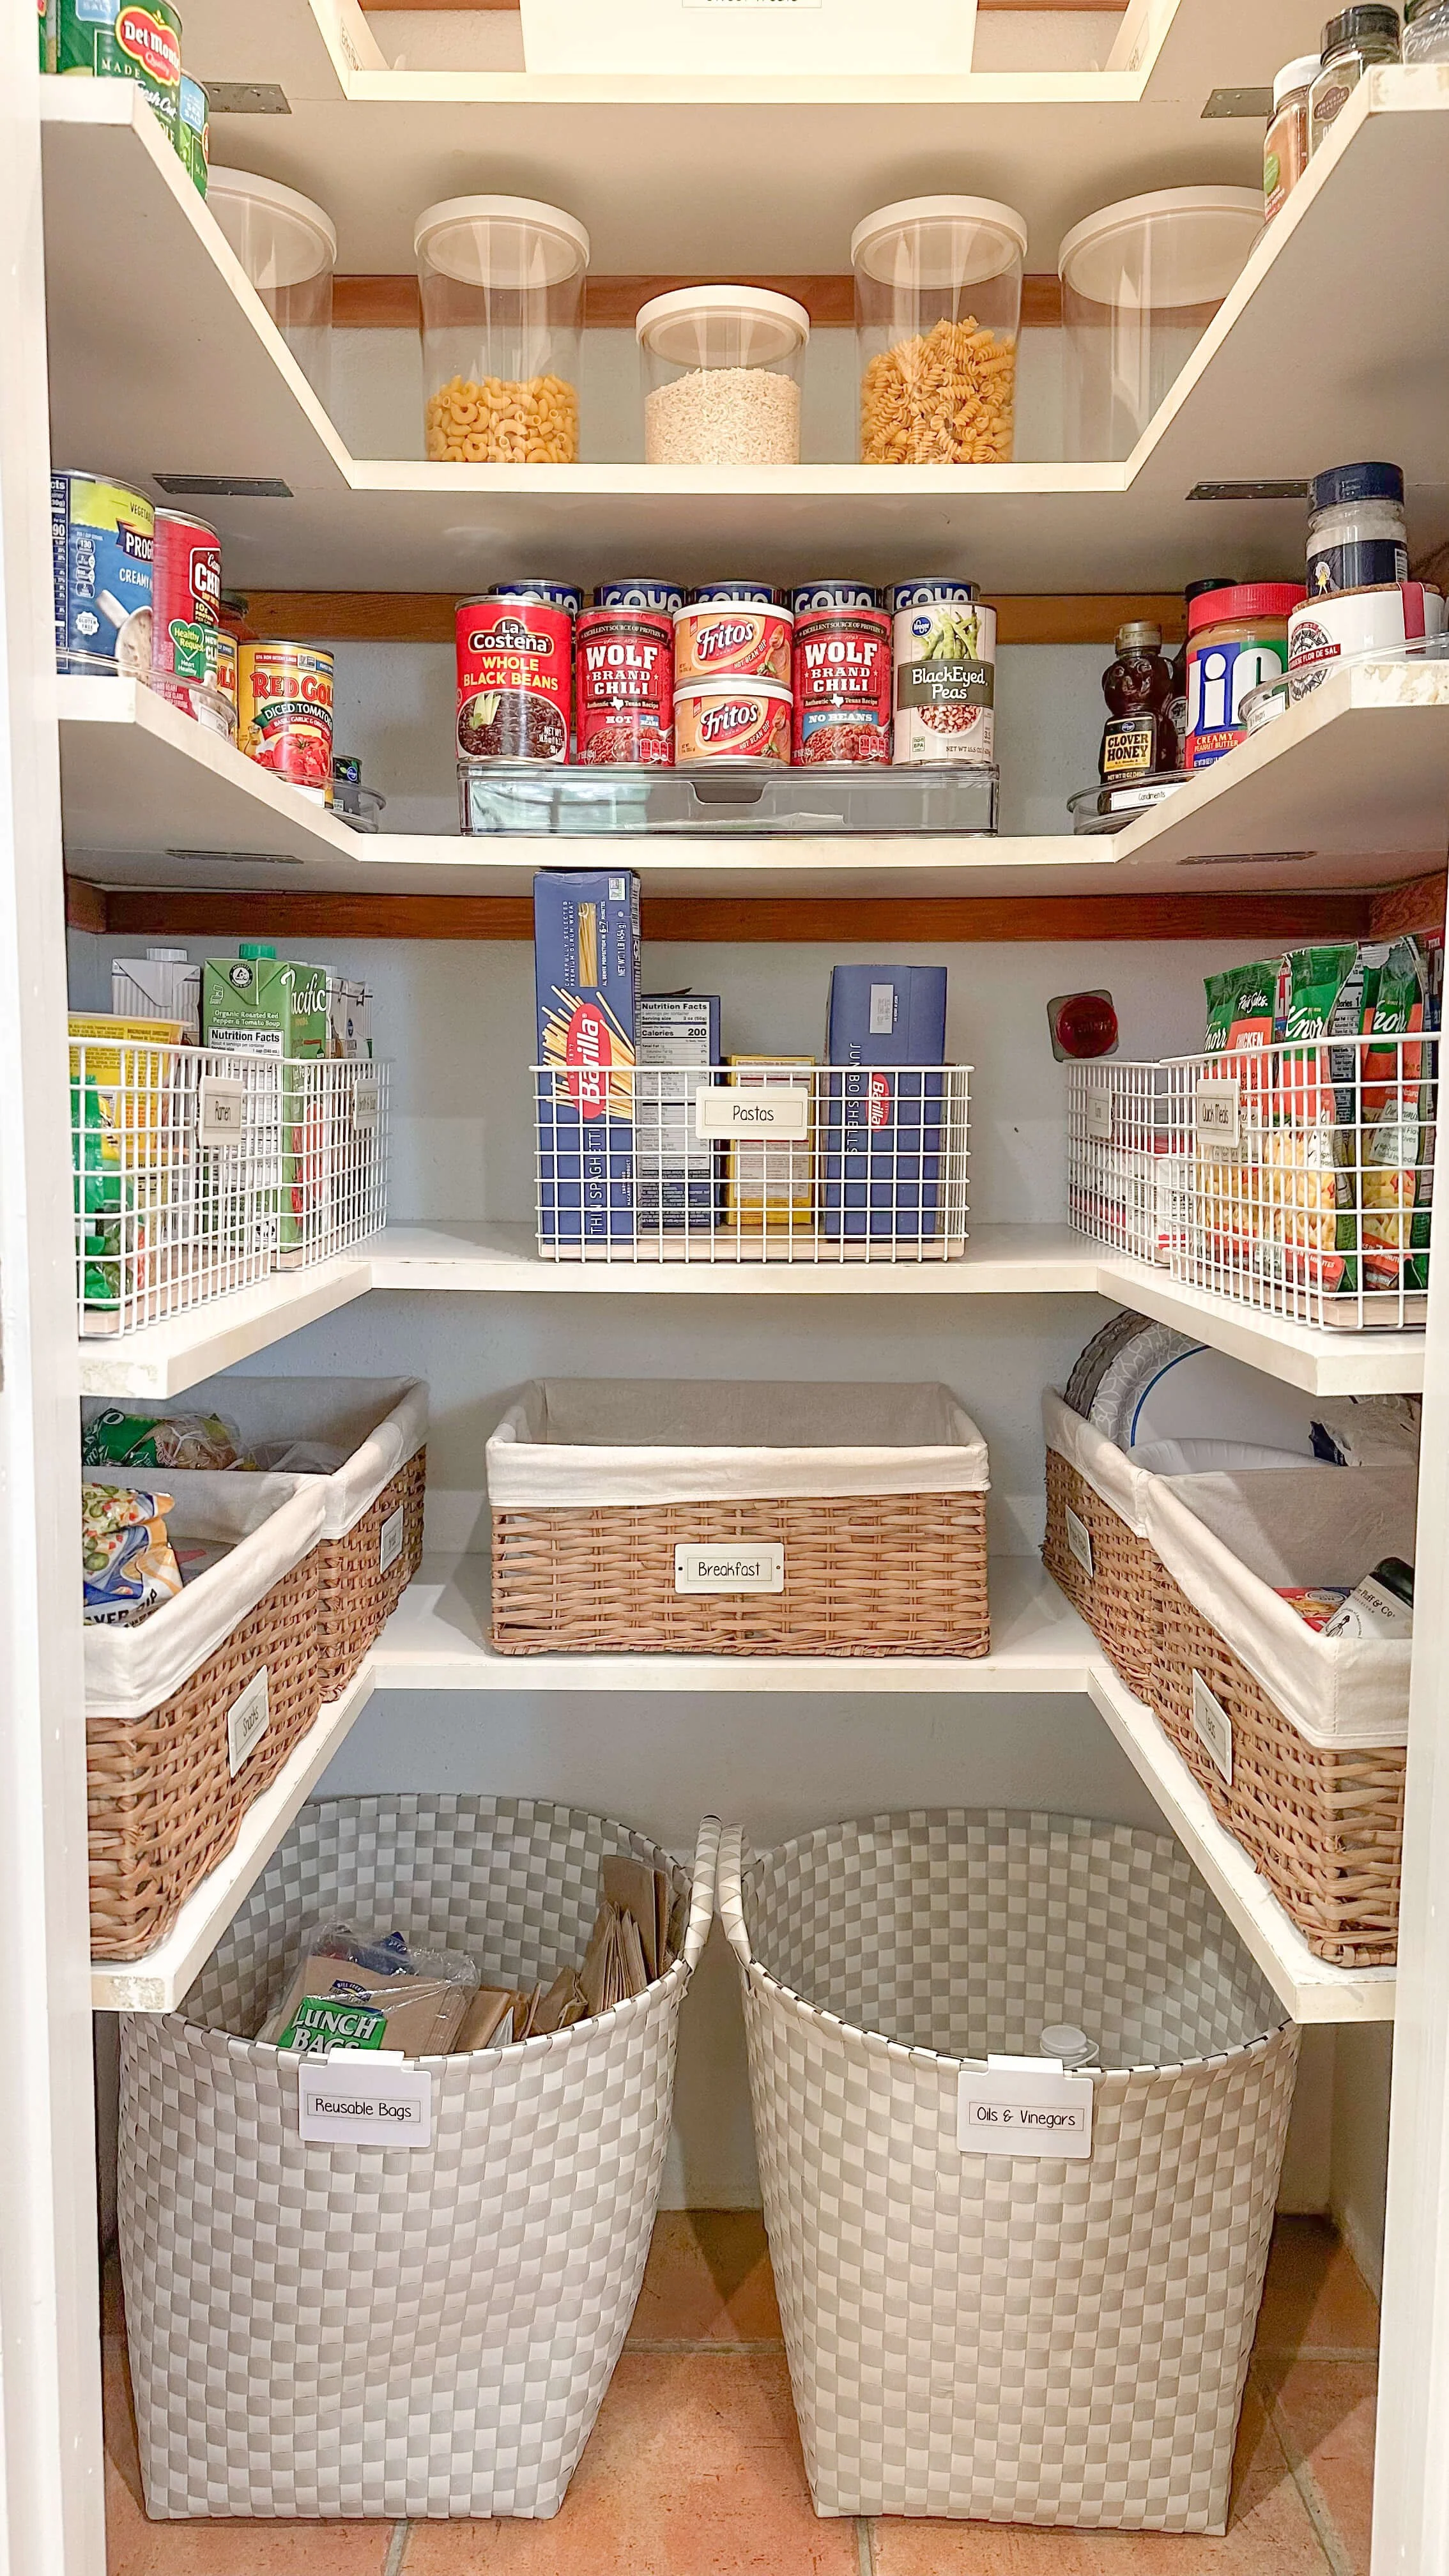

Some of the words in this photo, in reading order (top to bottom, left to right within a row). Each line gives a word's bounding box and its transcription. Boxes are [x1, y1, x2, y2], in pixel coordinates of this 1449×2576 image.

[125, 20, 148, 47] Del
[102, 57, 140, 78] MADE
[126, 532, 153, 560] PROG
[119, 567, 149, 588] CREAMY
[174, 627, 200, 641] Healthy
[502, 622, 518, 634] La
[914, 620, 930, 634] Kroger
[473, 634, 548, 652] Costeña
[696, 622, 755, 660] Fritos
[586, 644, 658, 671] WOLF
[734, 659, 745, 668] HOT
[745, 650, 759, 663] BEAN
[758, 639, 767, 654] DIP
[805, 641, 878, 669] WOLF
[1303, 653, 1315, 663] FLOR
[1326, 645, 1338, 656] SAL
[178, 666, 197, 676] Healthy
[482, 656, 539, 672] WHOLE
[592, 670, 650, 681] BRAND
[811, 667, 870, 678] BRAND
[250, 671, 299, 700] RED
[302, 675, 333, 708] GOL
[463, 672, 506, 687] BLACK
[511, 672, 558, 691] BEANS
[594, 681, 648, 695] CHILI
[813, 678, 868, 693] CHILI
[933, 684, 967, 700] Peas
[1186, 648, 1282, 735] Jif
[641, 701, 659, 709] Recipe
[861, 698, 878, 706] Recipe
[264, 703, 295, 719] DICED
[809, 713, 825, 723] NO
[830, 713, 873, 723] BEANS
[273, 718, 289, 727] BASIL
[606, 716, 633, 724] HOT
[700, 703, 758, 740] Fritos
[739, 740, 750, 750] HOT
[750, 732, 763, 744] BEAN
[762, 720, 770, 734] DIP
[1108, 733, 1149, 748] CLOVER
[1197, 733, 1234, 745] CREAMY
[1107, 745, 1149, 762] HONEY
[1194, 742, 1215, 753] PEANUT
[1215, 740, 1239, 749] BUTTER
[617, 941, 625, 950] LB
[617, 965, 625, 976] NET
[280, 969, 327, 1016] Pacific
[213, 1016, 234, 1025] Pepper
[265, 1020, 280, 1028] Soup
[215, 1010, 239, 1018] Organic
[1285, 1006, 1323, 1039] Knor
[211, 1029, 252, 1041] Nutrition
[256, 1032, 280, 1042] Facts
[578, 1018, 601, 1105] Barilla
[733, 1105, 774, 1121] Pastas
[698, 1561, 760, 1576] Breakfast
[1373, 1599, 1383, 1607] &
[293, 2008, 378, 2039] LUNCH
[316, 2099, 374, 2115] Reusable
[379, 2103, 411, 2120] Bags
[977, 2106, 998, 2122] Oils
[1003, 2110, 1013, 2122] &
[1021, 2110, 1075, 2128] Vinegars
